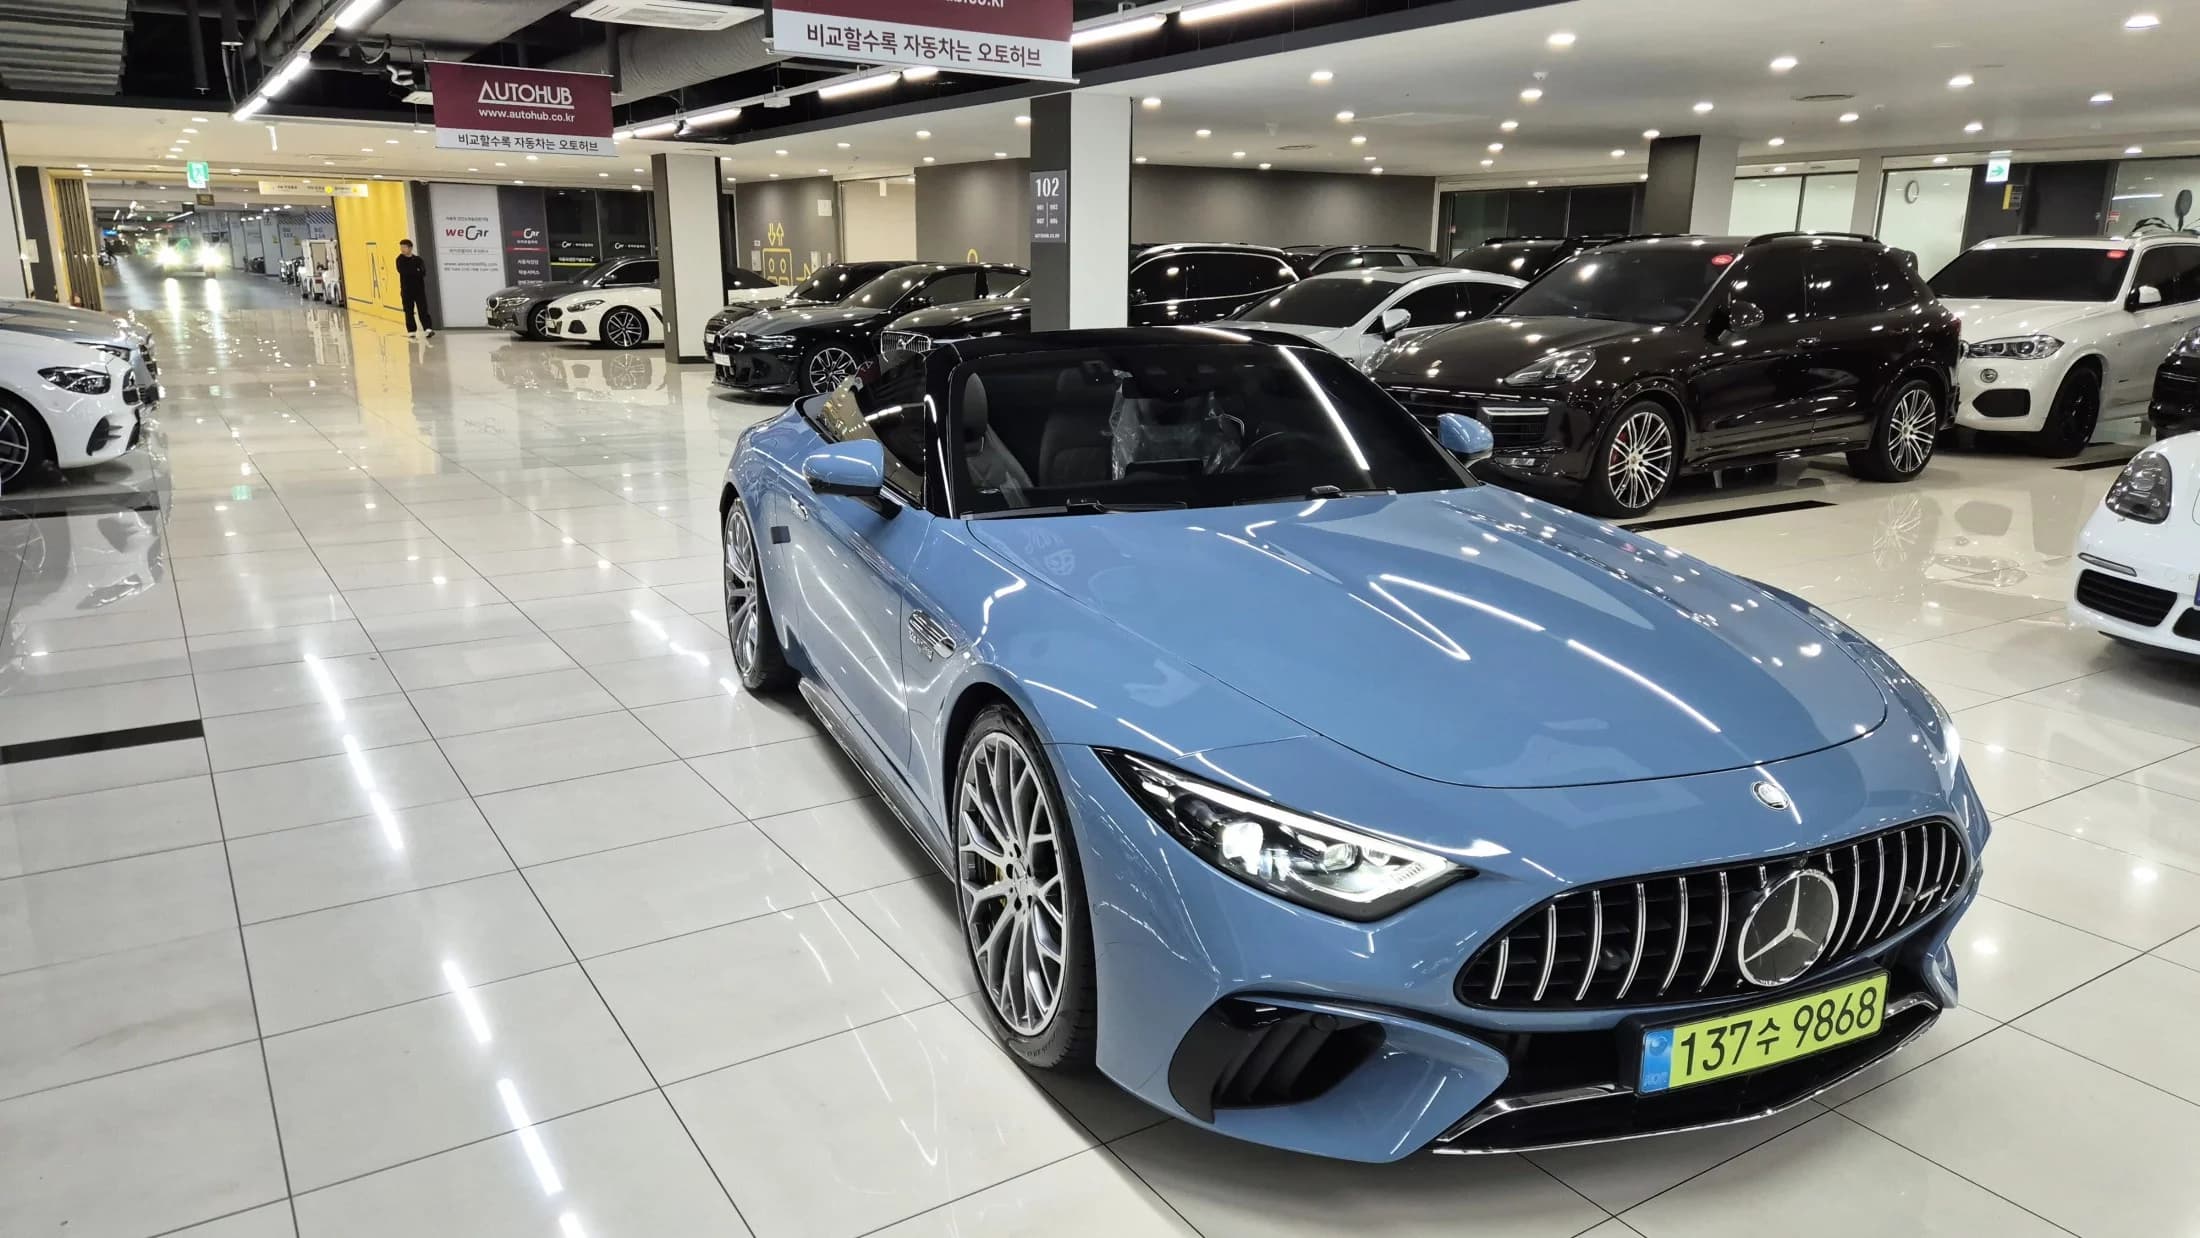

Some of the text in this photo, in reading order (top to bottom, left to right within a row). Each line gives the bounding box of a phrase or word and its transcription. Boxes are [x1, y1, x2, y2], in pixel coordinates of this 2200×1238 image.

[807, 23, 1041, 67] 비교할수록 자동차는 오토허브
[478, 80, 573, 107] AUTOHUB
[479, 108, 575, 122] www.autohub.co.kr
[458, 134, 599, 152] 비교할수록 자동차는 오토허브
[1035, 177, 1060, 197] 102
[445, 225, 489, 240] weCar
[1680, 986, 1877, 1076] 137수 9868
